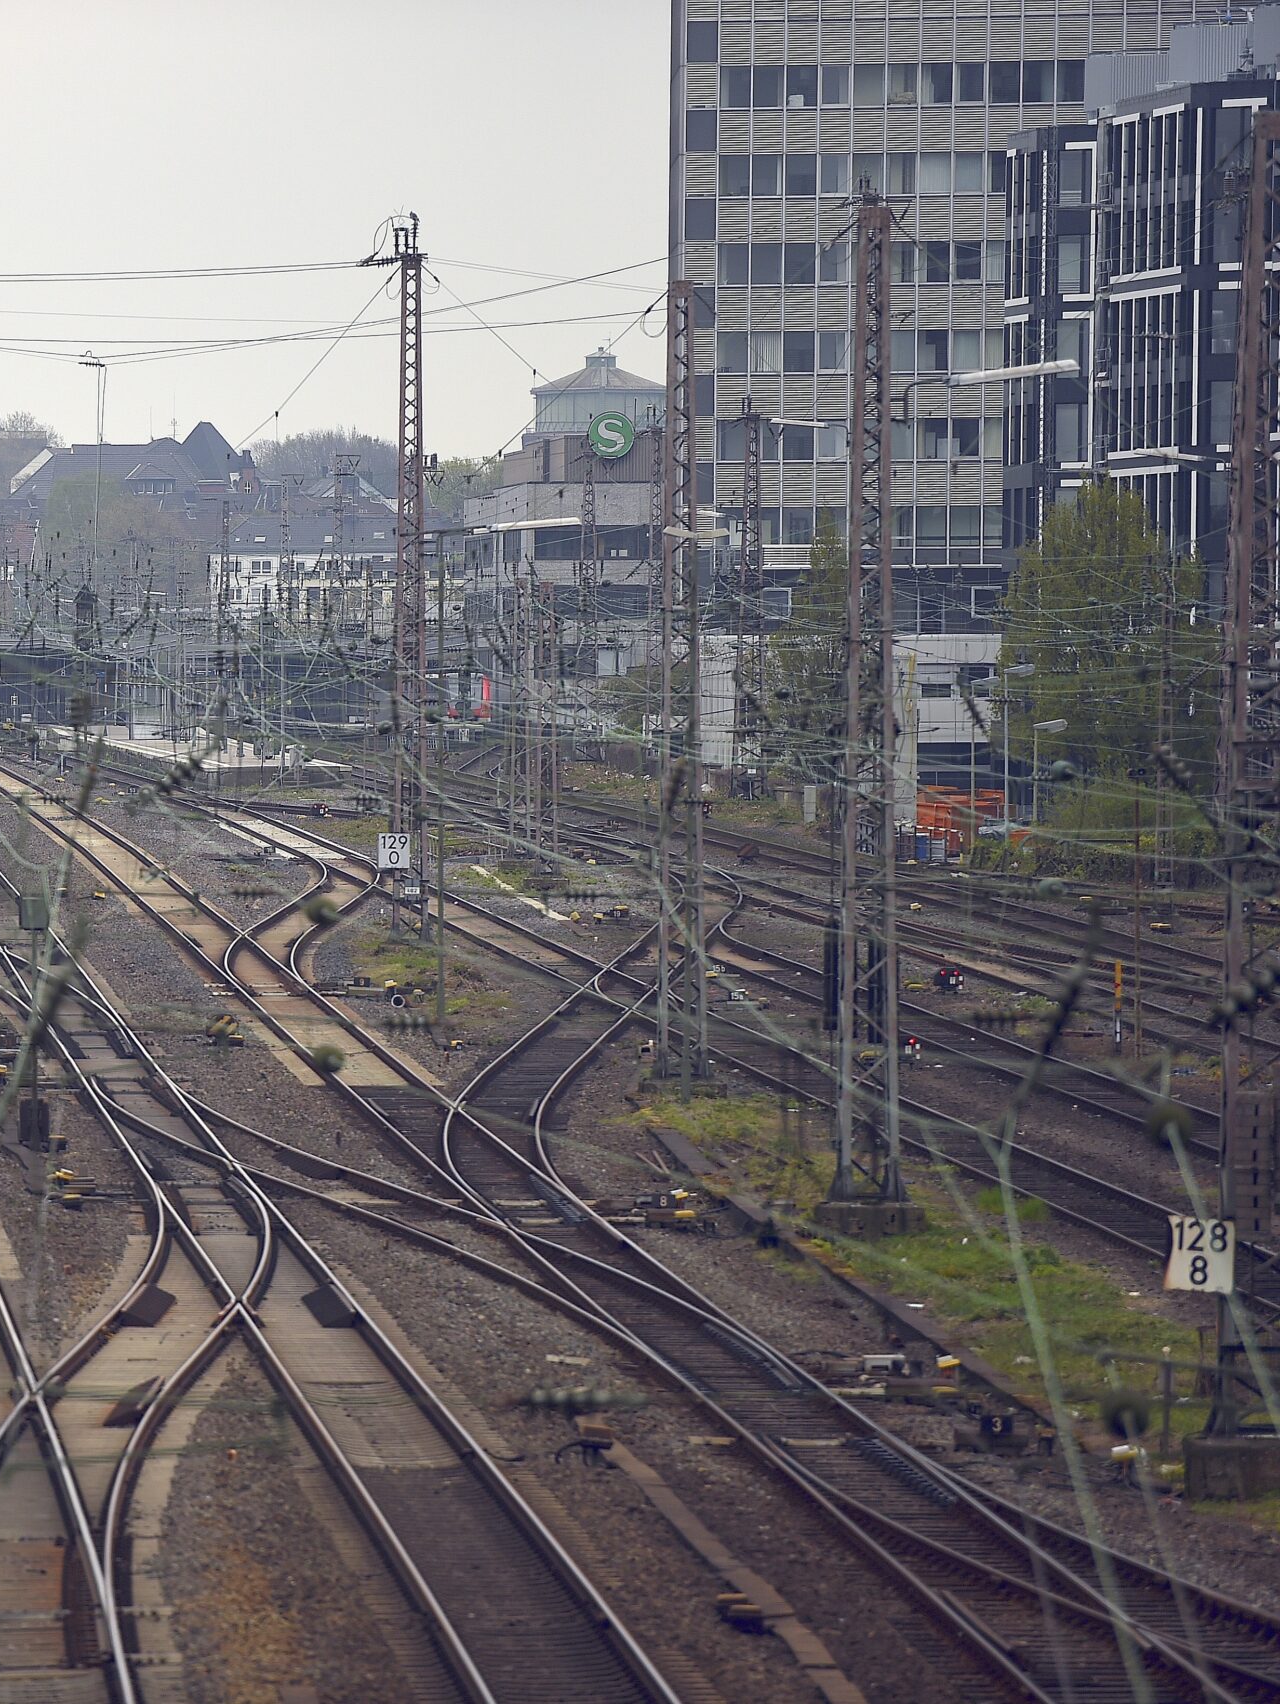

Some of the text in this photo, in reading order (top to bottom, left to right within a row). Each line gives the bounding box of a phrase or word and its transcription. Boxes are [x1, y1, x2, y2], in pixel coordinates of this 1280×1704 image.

[597, 419, 625, 453] S
[381, 835, 408, 850] 129
[388, 850, 400, 865] 0
[659, 1195, 668, 1207] 8
[1175, 1220, 1228, 1253] 128
[1190, 1255, 1208, 1286] 8
[991, 1417, 1002, 1432] 3
